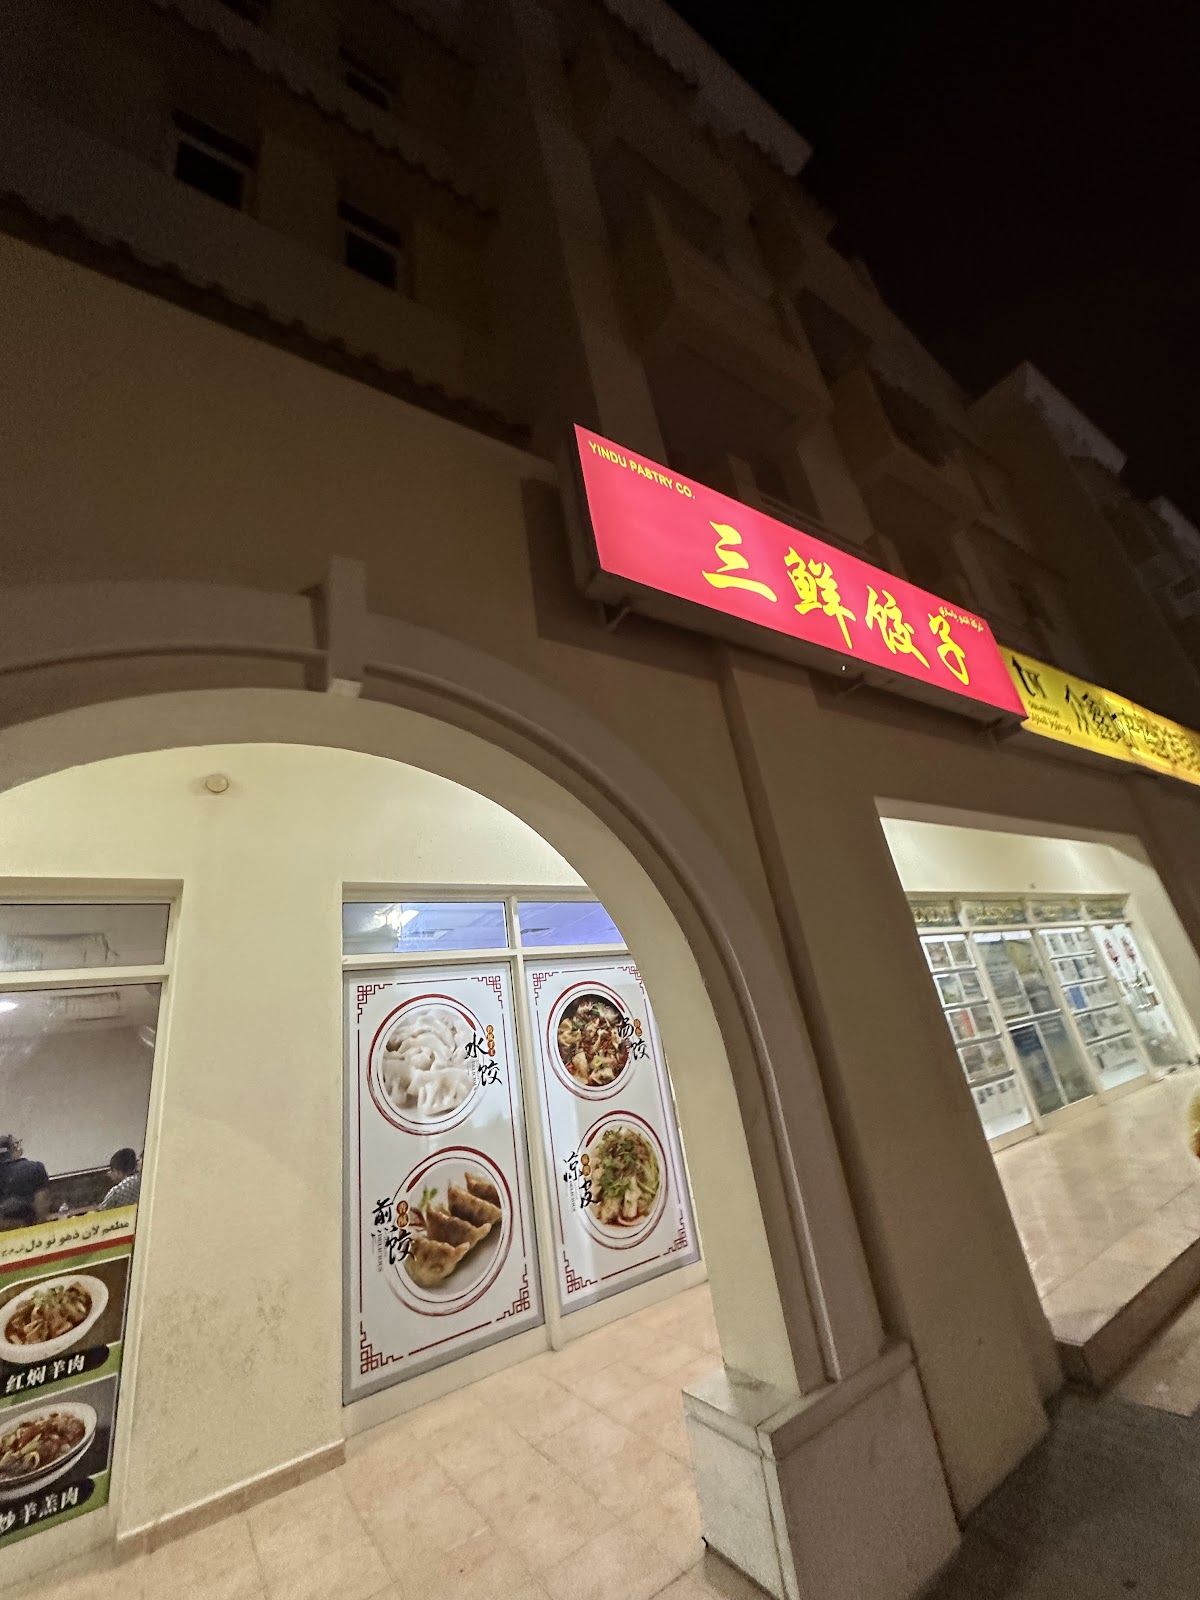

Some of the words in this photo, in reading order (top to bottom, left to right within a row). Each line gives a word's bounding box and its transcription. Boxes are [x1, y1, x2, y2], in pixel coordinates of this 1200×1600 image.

[588, 440, 627, 468] YINDU
[629, 460, 673, 489] PASTRY
[675, 481, 696, 500] CO.
[701, 520, 970, 686] 三鲜饺子
[464, 1031, 503, 1087] 水饺
[563, 1150, 600, 1209] 凉皮
[102, 1220, 130, 1236] مطعم
[371, 1197, 416, 1265] 煎饺
[5, 1354, 86, 1394] 红焖羊肉
